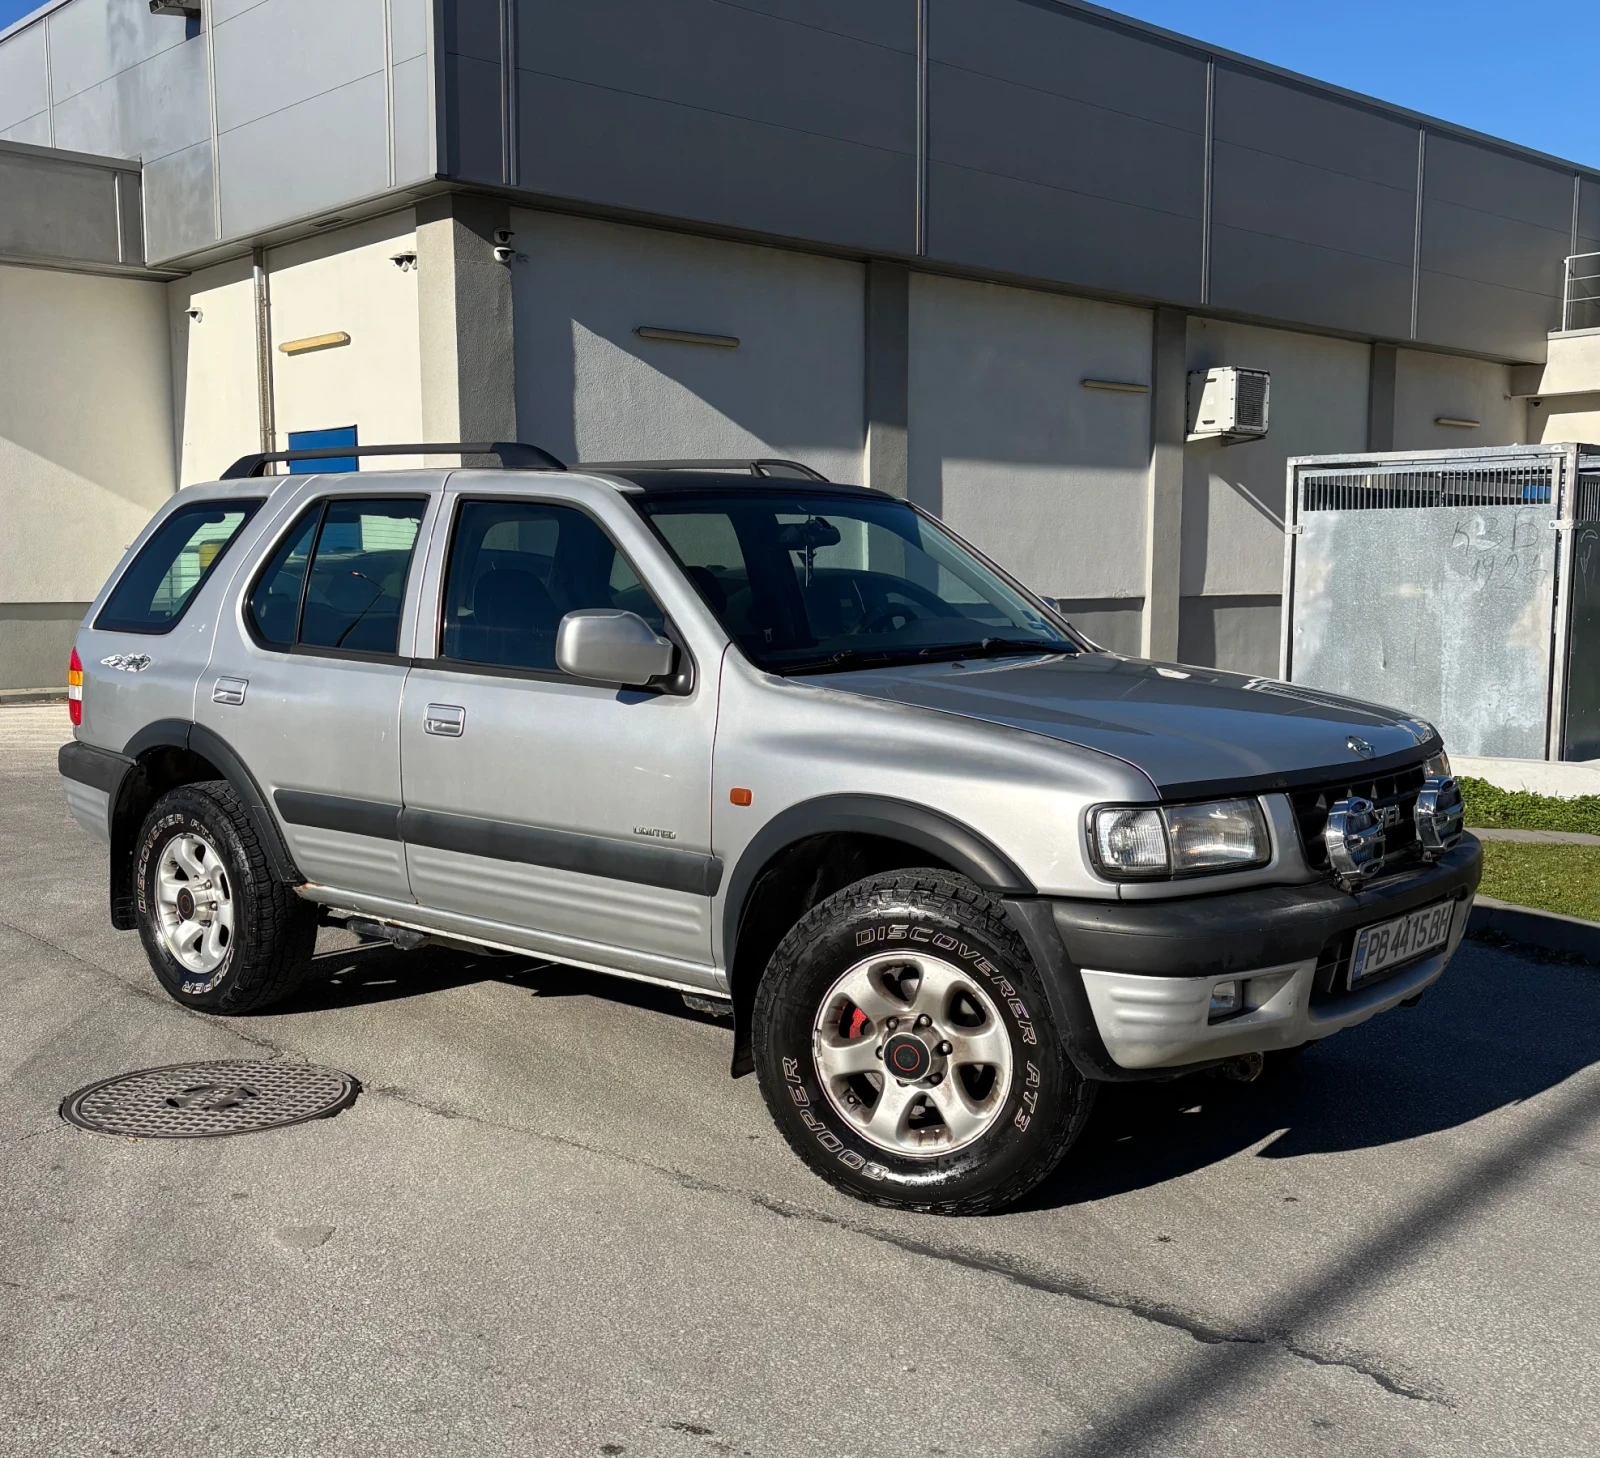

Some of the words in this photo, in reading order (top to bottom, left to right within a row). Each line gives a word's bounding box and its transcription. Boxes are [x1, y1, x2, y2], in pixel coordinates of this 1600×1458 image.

[137, 813, 185, 914] DISCOVERER
[855, 923, 1038, 1046] DISCOVERER
[1013, 1060, 1042, 1133] AT3
[781, 1056, 890, 1181] COOPER
